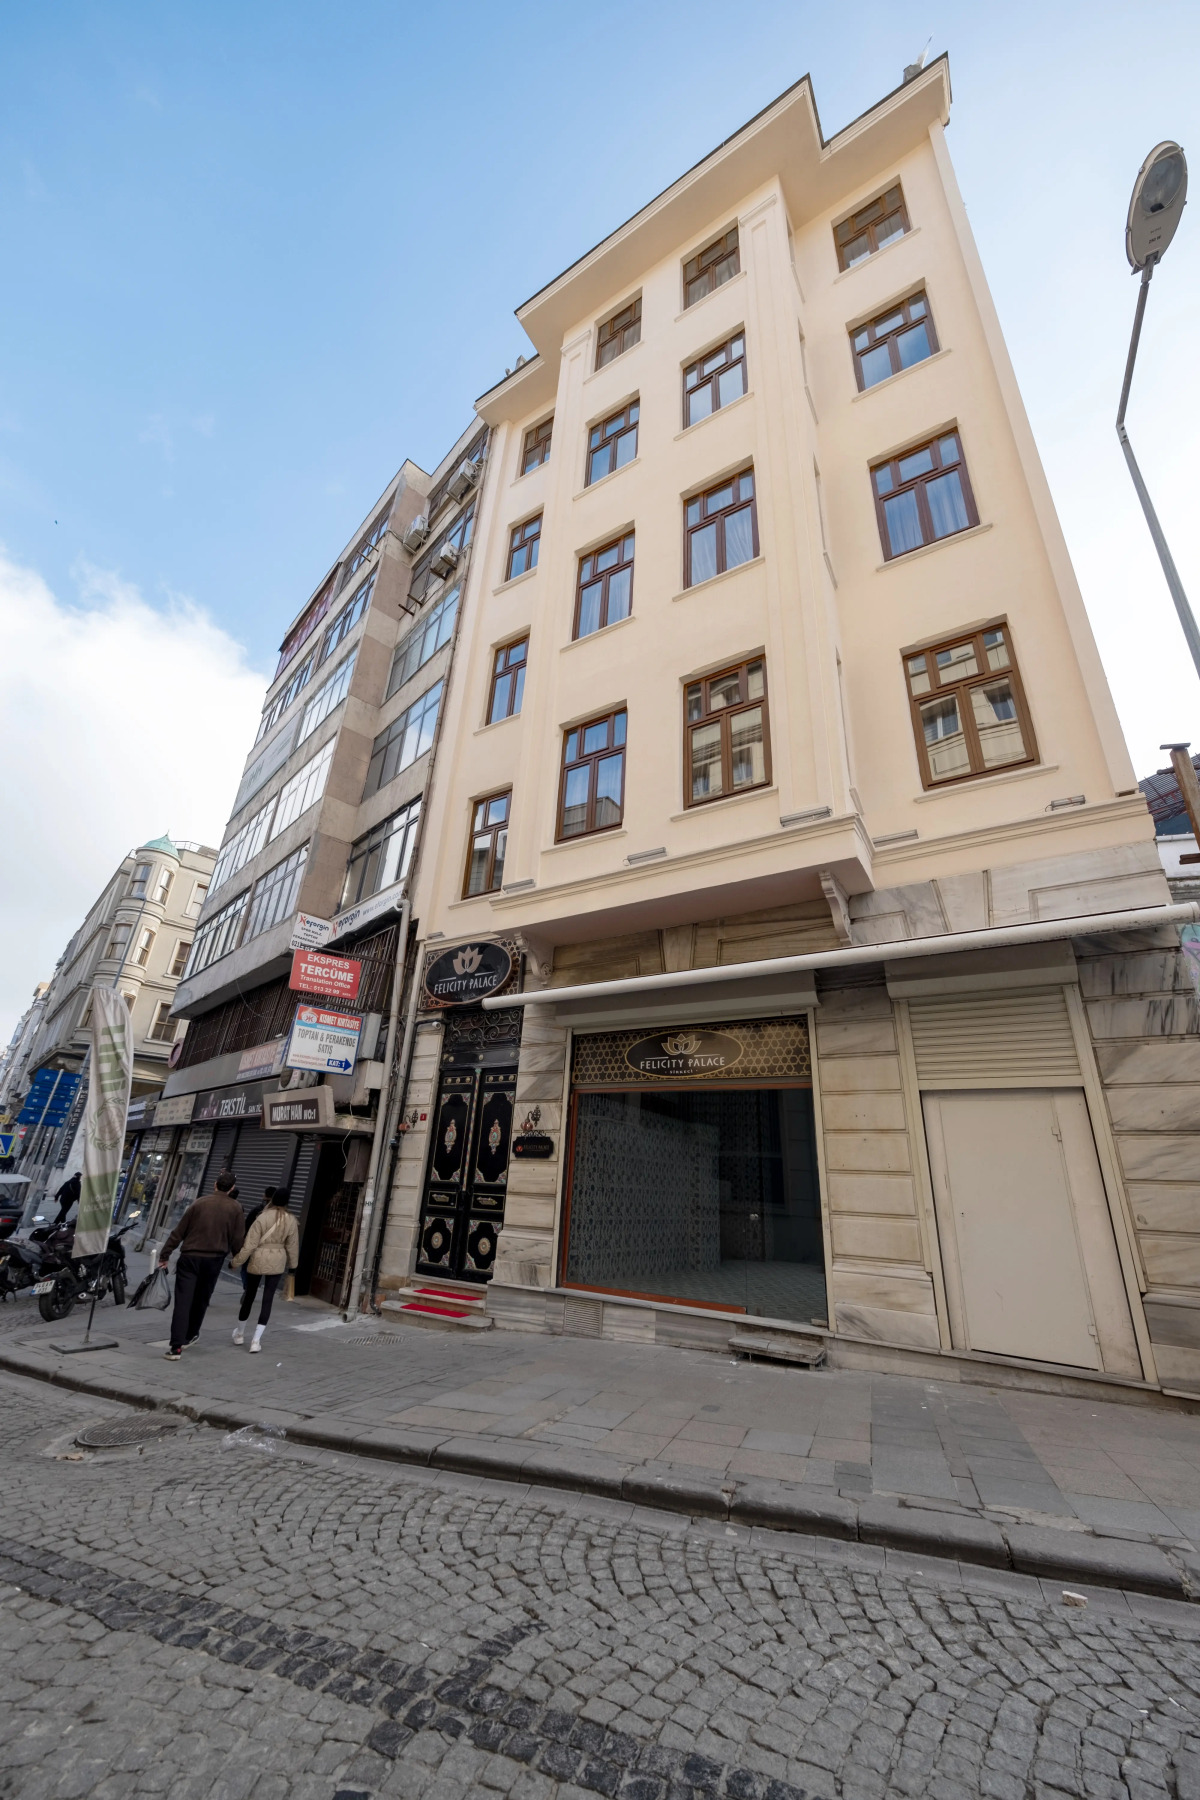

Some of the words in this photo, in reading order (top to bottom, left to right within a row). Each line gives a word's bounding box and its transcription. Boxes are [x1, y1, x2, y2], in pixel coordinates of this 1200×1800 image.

[307, 954, 350, 969] EKSPRES
[300, 963, 354, 983] TERCÜME
[300, 975, 333, 986] Translation
[333, 981, 351, 989] Office
[434, 980, 468, 994] FELICITY
[469, 975, 498, 990] PALACE
[297, 1028, 319, 1041] TOPTAN
[319, 1032, 324, 1042] &
[325, 1033, 356, 1047] PERAKENDE
[317, 1043, 333, 1057] SATIŞ
[328, 1059, 341, 1067] KAT:
[640, 1059, 684, 1070] FELICITY
[688, 1056, 725, 1067] PALACE
[220, 1092, 246, 1116] TEKSTİL
[271, 1105, 290, 1121] MURAT
[290, 1103, 303, 1120] HAN
[60, 1130, 74, 1159] PALACE
